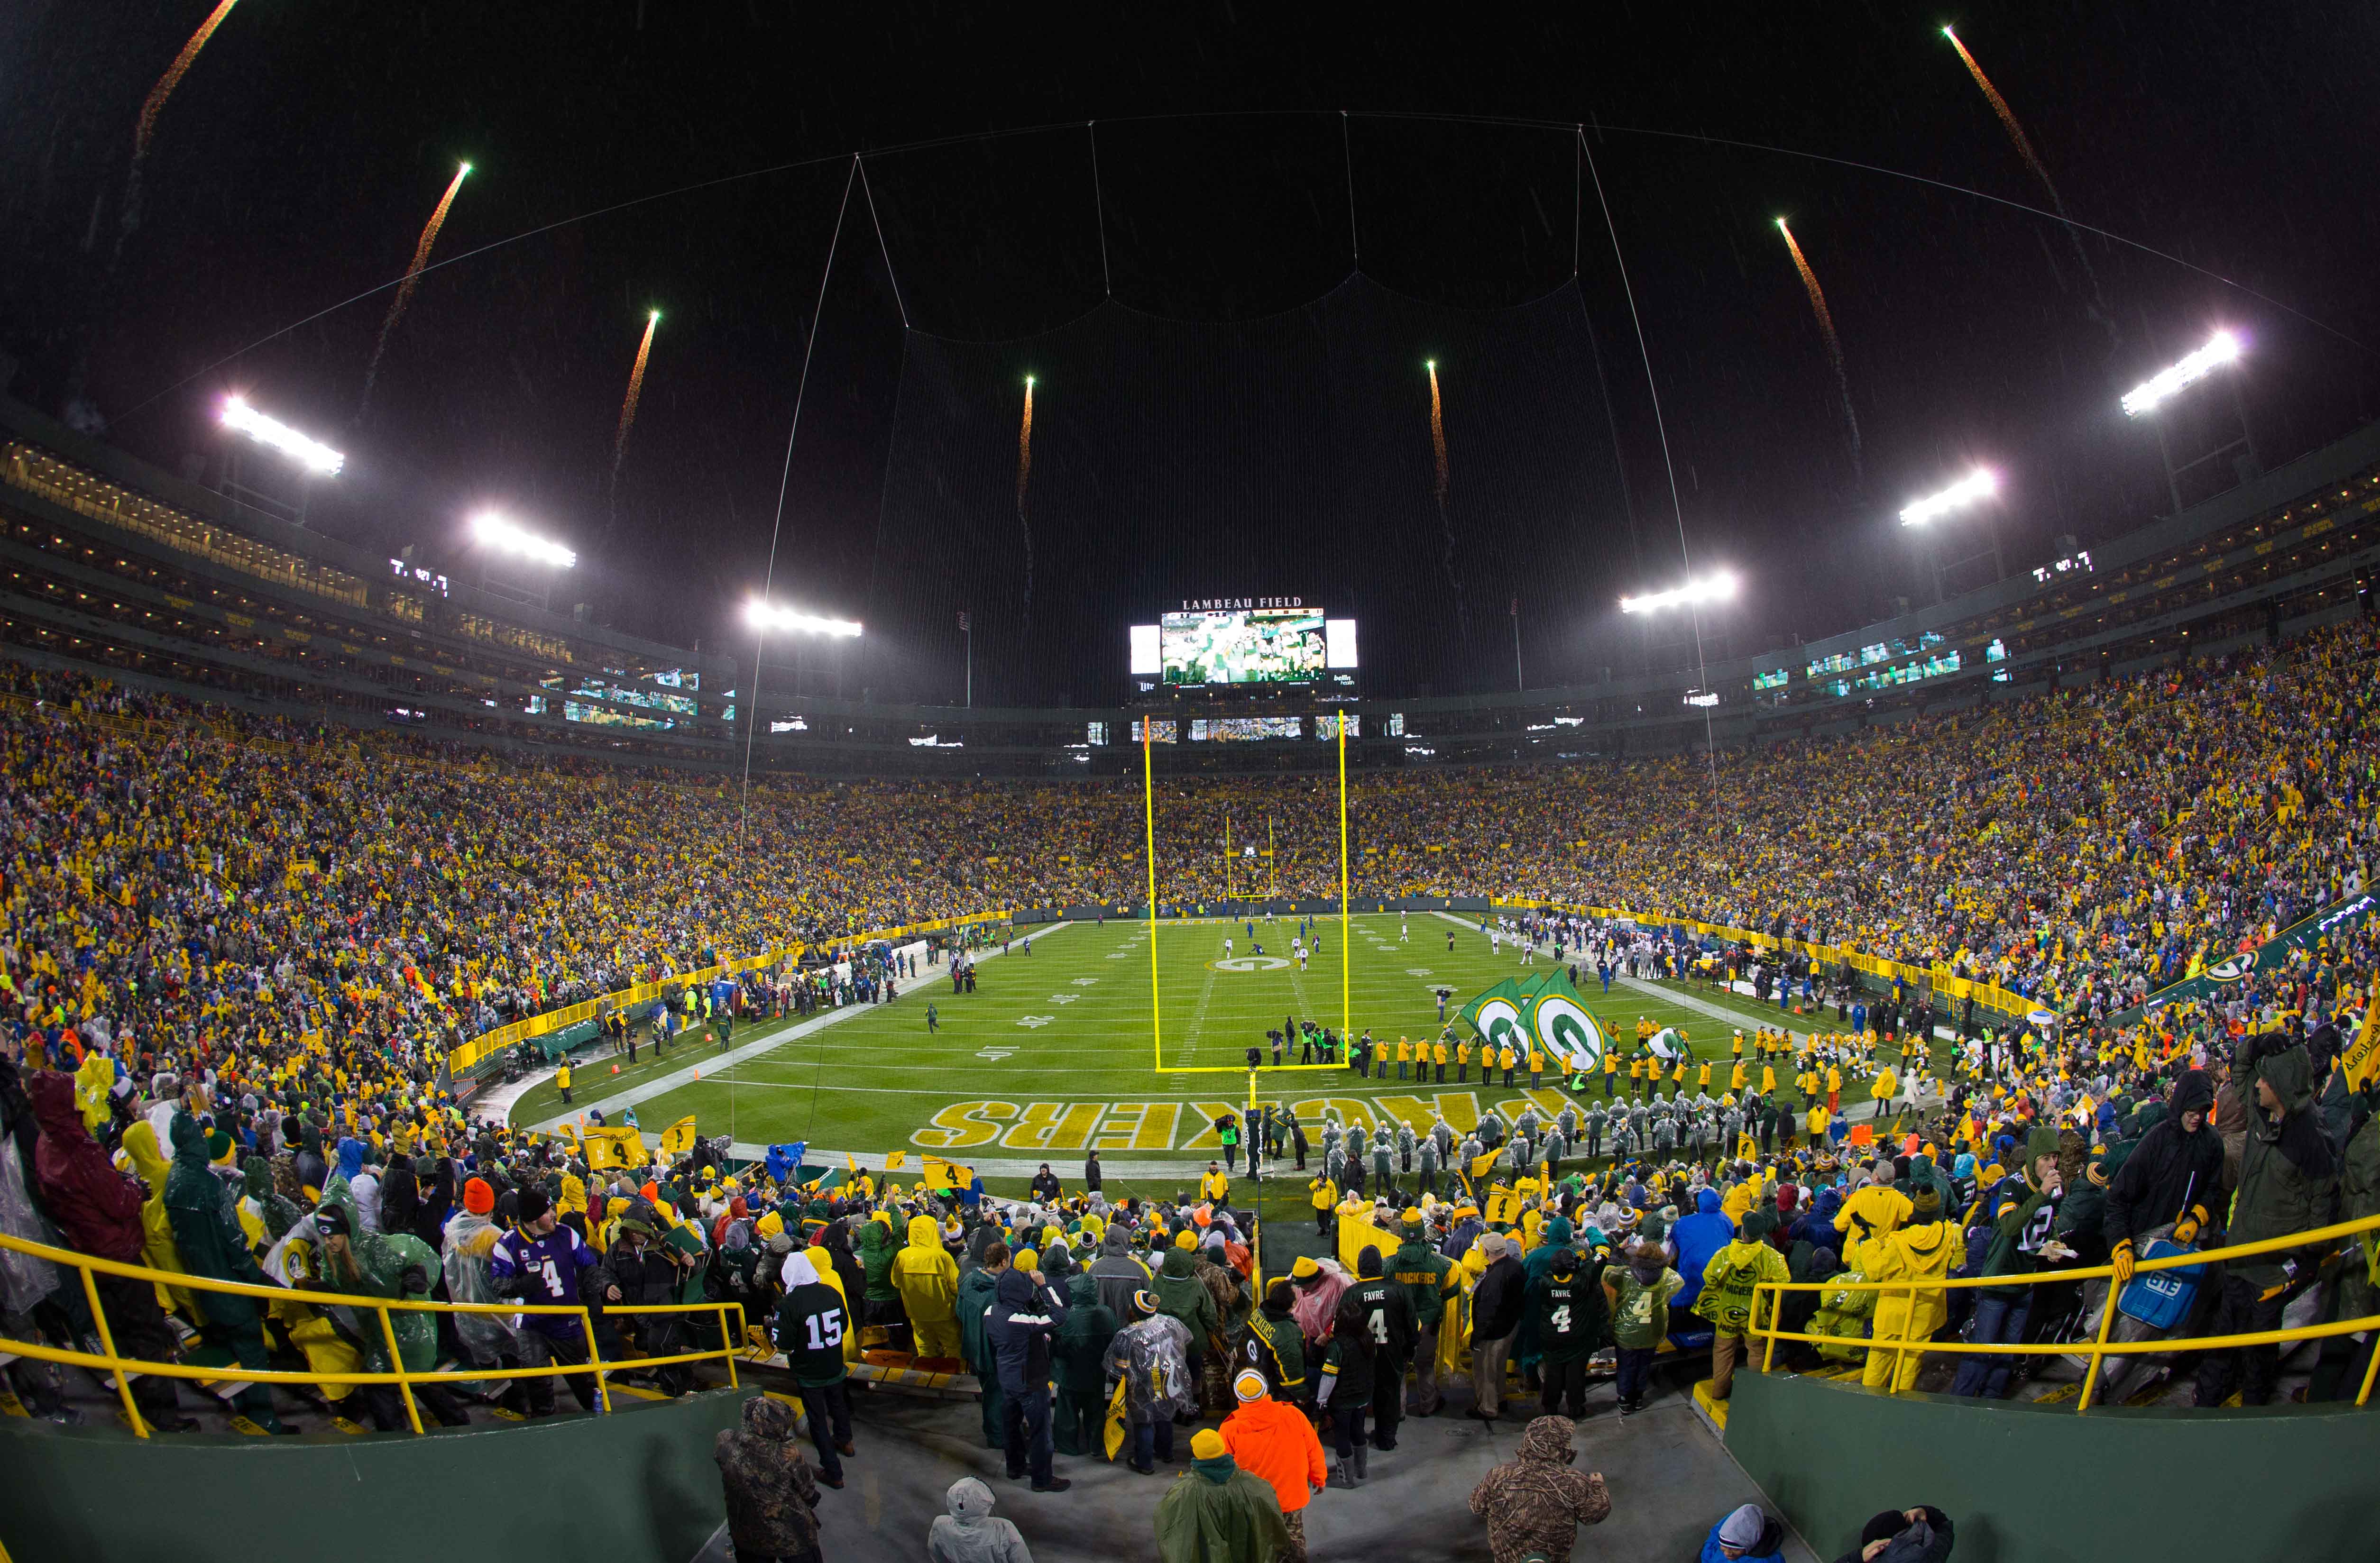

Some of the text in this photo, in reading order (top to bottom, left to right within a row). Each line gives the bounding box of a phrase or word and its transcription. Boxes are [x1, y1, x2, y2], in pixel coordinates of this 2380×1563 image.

[1183, 598, 1252, 610] LAMBEAU
[1259, 597, 1302, 607] FIELD
[1016, 1016, 1055, 1026] 20
[975, 1045, 1020, 1058] 10
[609, 1129, 636, 1142] Packers
[612, 1142, 629, 1166] 4
[946, 1166, 959, 1185] 4
[1498, 1198, 1508, 1219] 4
[319, 1225, 331, 1234] G
[2017, 1205, 2054, 1251] 12
[520, 1249, 529, 1257] C
[542, 1260, 565, 1297] 4
[729, 1271, 749, 1293] 4
[1395, 1272, 1436, 1285] PACKERS
[1363, 1289, 1385, 1302] FAVRE
[1551, 1289, 1571, 1298] FAVRE
[1633, 1291, 1652, 1324] 4
[806, 1307, 843, 1350] 15
[1250, 1309, 1276, 1340] PACKERS
[1368, 1308, 1388, 1344] 4
[1551, 1305, 1571, 1333] 4
[1247, 1339, 1259, 1362] G
